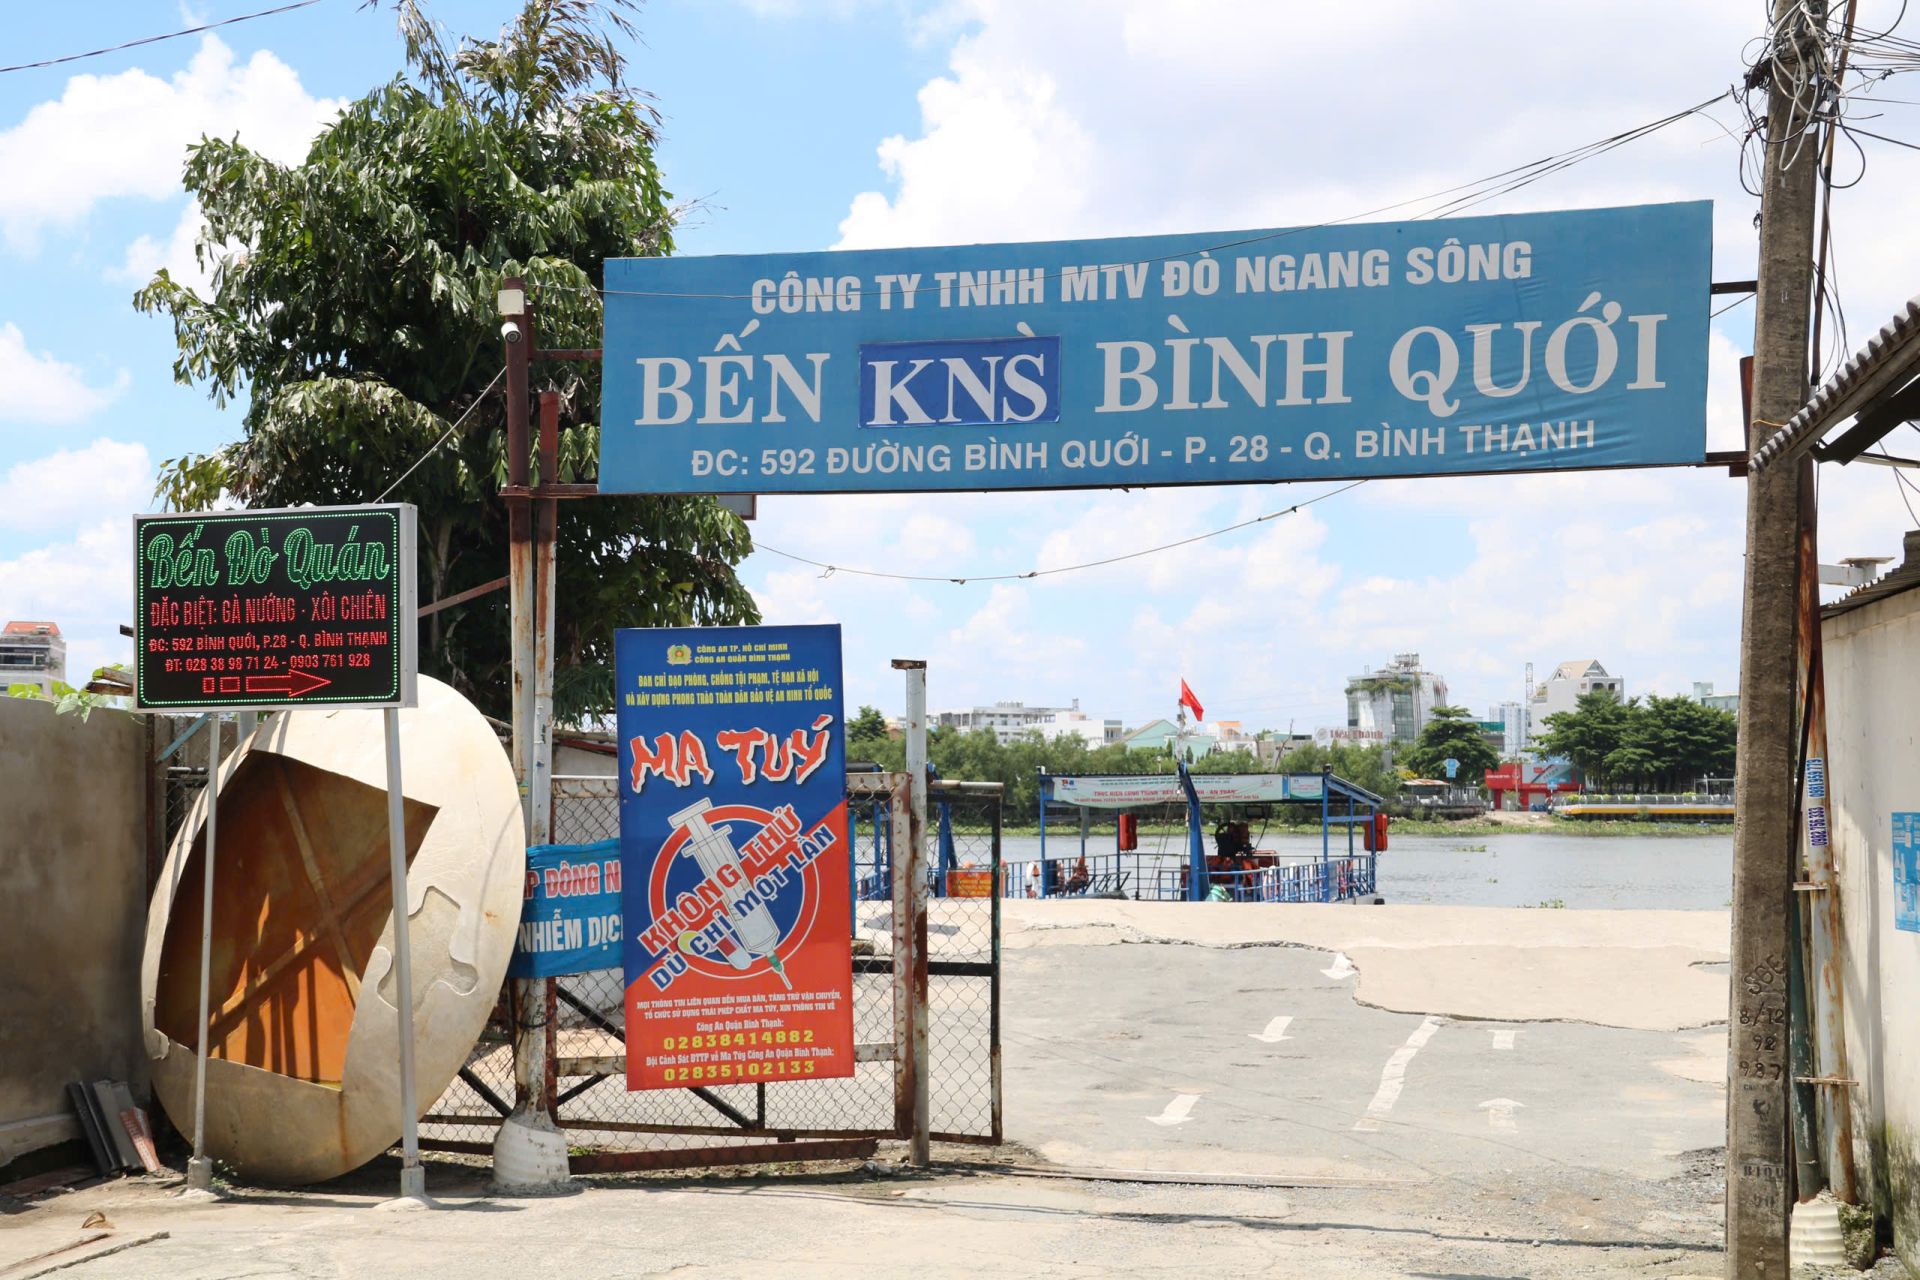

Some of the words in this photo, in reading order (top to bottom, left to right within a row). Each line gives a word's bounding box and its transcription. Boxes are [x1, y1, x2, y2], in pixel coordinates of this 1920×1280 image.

[751, 271, 861, 315] CÔNG
[875, 273, 921, 310] TY
[933, 267, 1045, 307] TNHH
[1061, 262, 1150, 301] MTV
[1162, 251, 1220, 298] ĐÒ
[1235, 249, 1390, 294] NGANG
[1405, 237, 1532, 283] SÔNG
[634, 319, 831, 427] BẾN
[866, 353, 1048, 427] KNS
[1095, 314, 1354, 413] BÌNH
[1389, 291, 1668, 418] QUỚI
[691, 449, 750, 476] ĐC:
[761, 448, 815, 475] 592
[827, 439, 953, 474] ĐƯỜNG
[964, 436, 1047, 470] BÌNH
[1060, 431, 1149, 468] QUỚI
[1184, 437, 1216, 464] P.
[1229, 436, 1269, 462] 28
[1304, 431, 1342, 462] Q.
[1354, 421, 1446, 458] BÌNH
[1459, 420, 1596, 458] THẠNH
[147, 525, 220, 589] Bến
[225, 527, 280, 586] Đò
[283, 525, 390, 590] Quán
[150, 596, 179, 632] ĐẶC
[183, 594, 217, 631] BIỆT:
[222, 593, 241, 624] GÀ
[245, 592, 296, 624] NƯỚNG
[311, 591, 336, 621] XÔI
[341, 588, 387, 620] CHIÊN
[149, 638, 169, 652] ĐC:
[172, 637, 194, 651] 592
[197, 632, 225, 650] BÌNH
[263, 634, 287, 649] P.28
[299, 634, 311, 648] Q.
[314, 629, 344, 647] BÌNH
[347, 631, 387, 649] THẠNH
[185, 658, 207, 671] 028
[210, 657, 225, 671] 38
[228, 657, 242, 670] 98
[246, 656, 259, 669] 71
[263, 655, 279, 669] 24
[290, 655, 319, 669] 0903
[323, 653, 344, 667] 761
[348, 653, 371, 667] 928
[625, 691, 635, 706] VÀ
[636, 691, 650, 706] XÂY
[651, 692, 670, 708] DỰNG
[672, 692, 695, 705] PHONG
[696, 690, 714, 704] TRÀO
[715, 689, 732, 704] TOÀN
[734, 689, 748, 704] DÂN
[750, 687, 763, 703] BẢO
[765, 688, 774, 704] VỆ
[776, 689, 784, 702] AN
[786, 689, 803, 701] NINH
[804, 684, 812, 701] TỔ
[814, 684, 832, 700] QUỐC
[638, 675, 652, 687] BAN
[654, 671, 667, 687] CHỈ
[668, 674, 682, 689] ĐẠO
[710, 669, 733, 686] CHỐNG
[735, 670, 746, 687] TỘI
[771, 669, 780, 686] TỆ
[781, 671, 795, 686] NẠN
[796, 668, 805, 682] XÃ
[807, 667, 819, 684] HỘI
[630, 729, 714, 793] MA
[716, 714, 833, 785] TUÝ
[637, 863, 742, 957] KHÔNG
[740, 803, 803, 866] THỬ
[648, 954, 688, 992] DÙ
[689, 911, 732, 957] CHỈ
[733, 865, 788, 919] MỘT
[786, 823, 837, 873] LẦN
[518, 908, 583, 953] NHIỄM
[588, 914, 623, 951] DỊC
[663, 1029, 814, 1050] 02838414882
[714, 1020, 724, 1031] An
[663, 1060, 815, 1081] 02835102133
[765, 1048, 774, 1058] An
